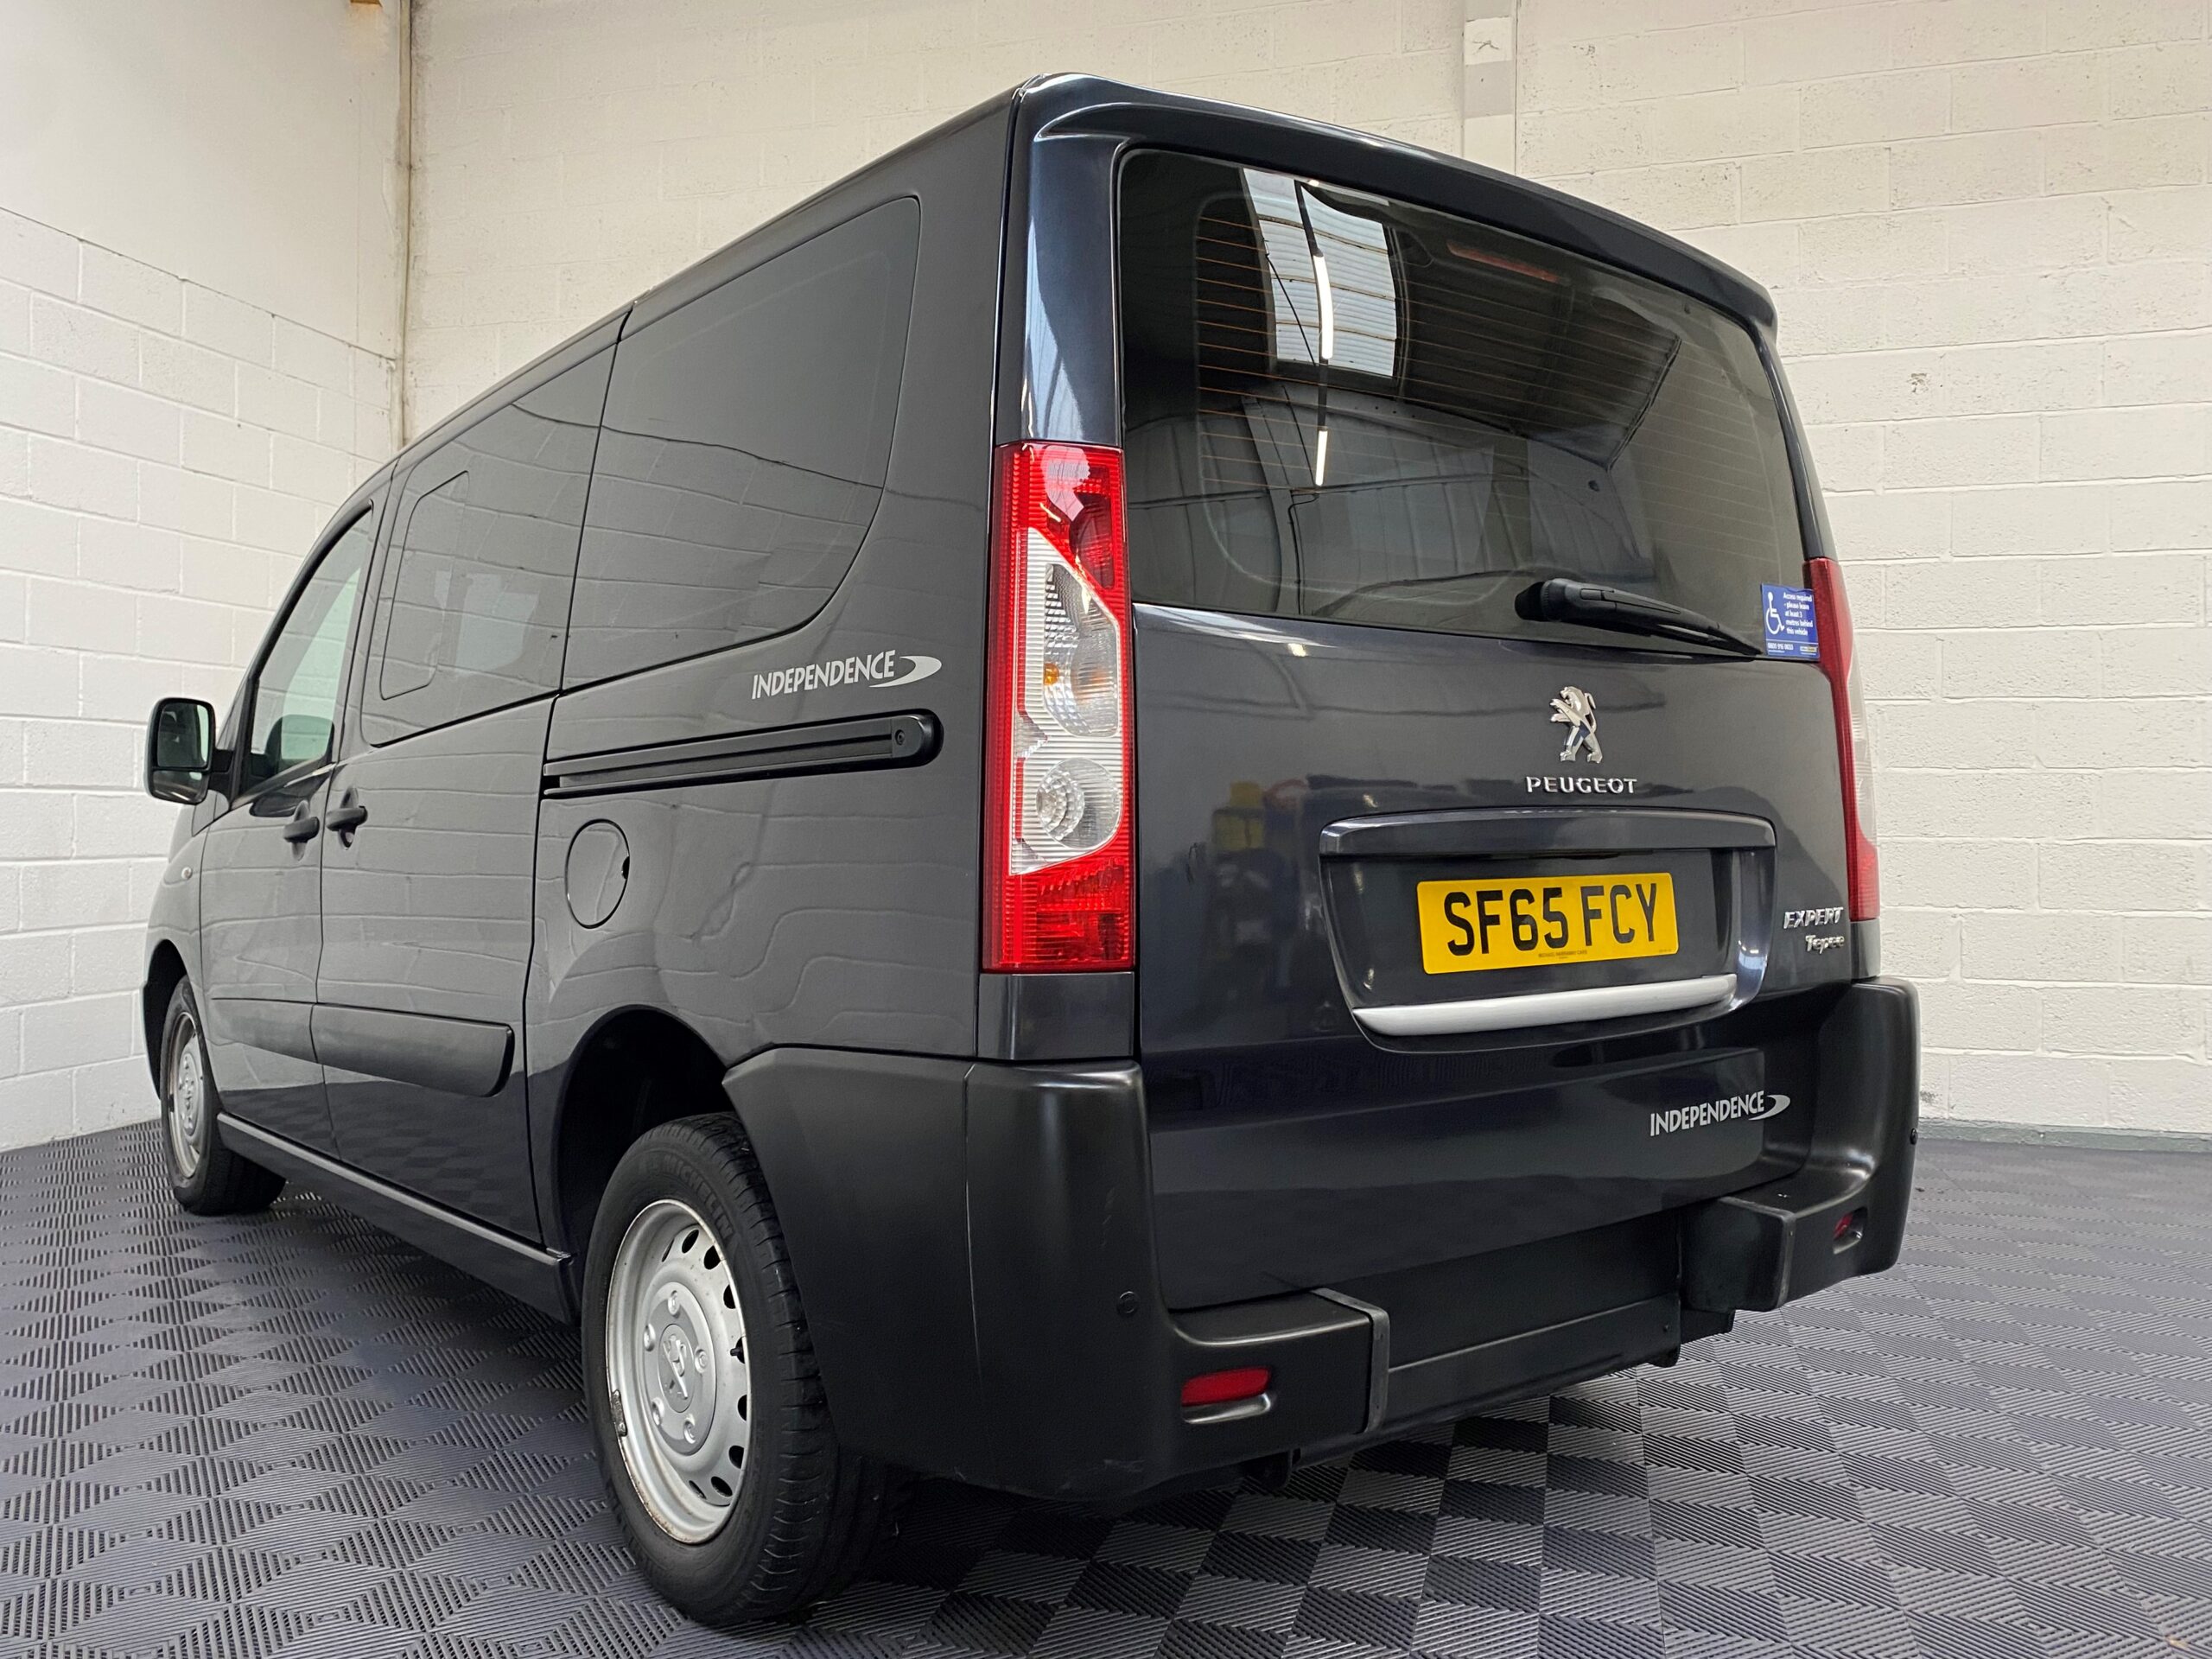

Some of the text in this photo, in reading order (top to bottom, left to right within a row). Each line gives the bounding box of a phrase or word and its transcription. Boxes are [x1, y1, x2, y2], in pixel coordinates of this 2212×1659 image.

[1796, 594, 1812, 602] required
[1799, 601, 1809, 610] leave
[751, 650, 896, 700] INDEPENDENCE
[1526, 776, 1637, 794] PEUGEOT
[1444, 883, 1657, 957] SF65 FCY
[1783, 906, 1844, 929] EXPERT
[1805, 934, 1845, 954] Tepee
[1649, 1090, 1764, 1137] INDEPENDENCE
[663, 1154, 734, 1241] MICHELIN
